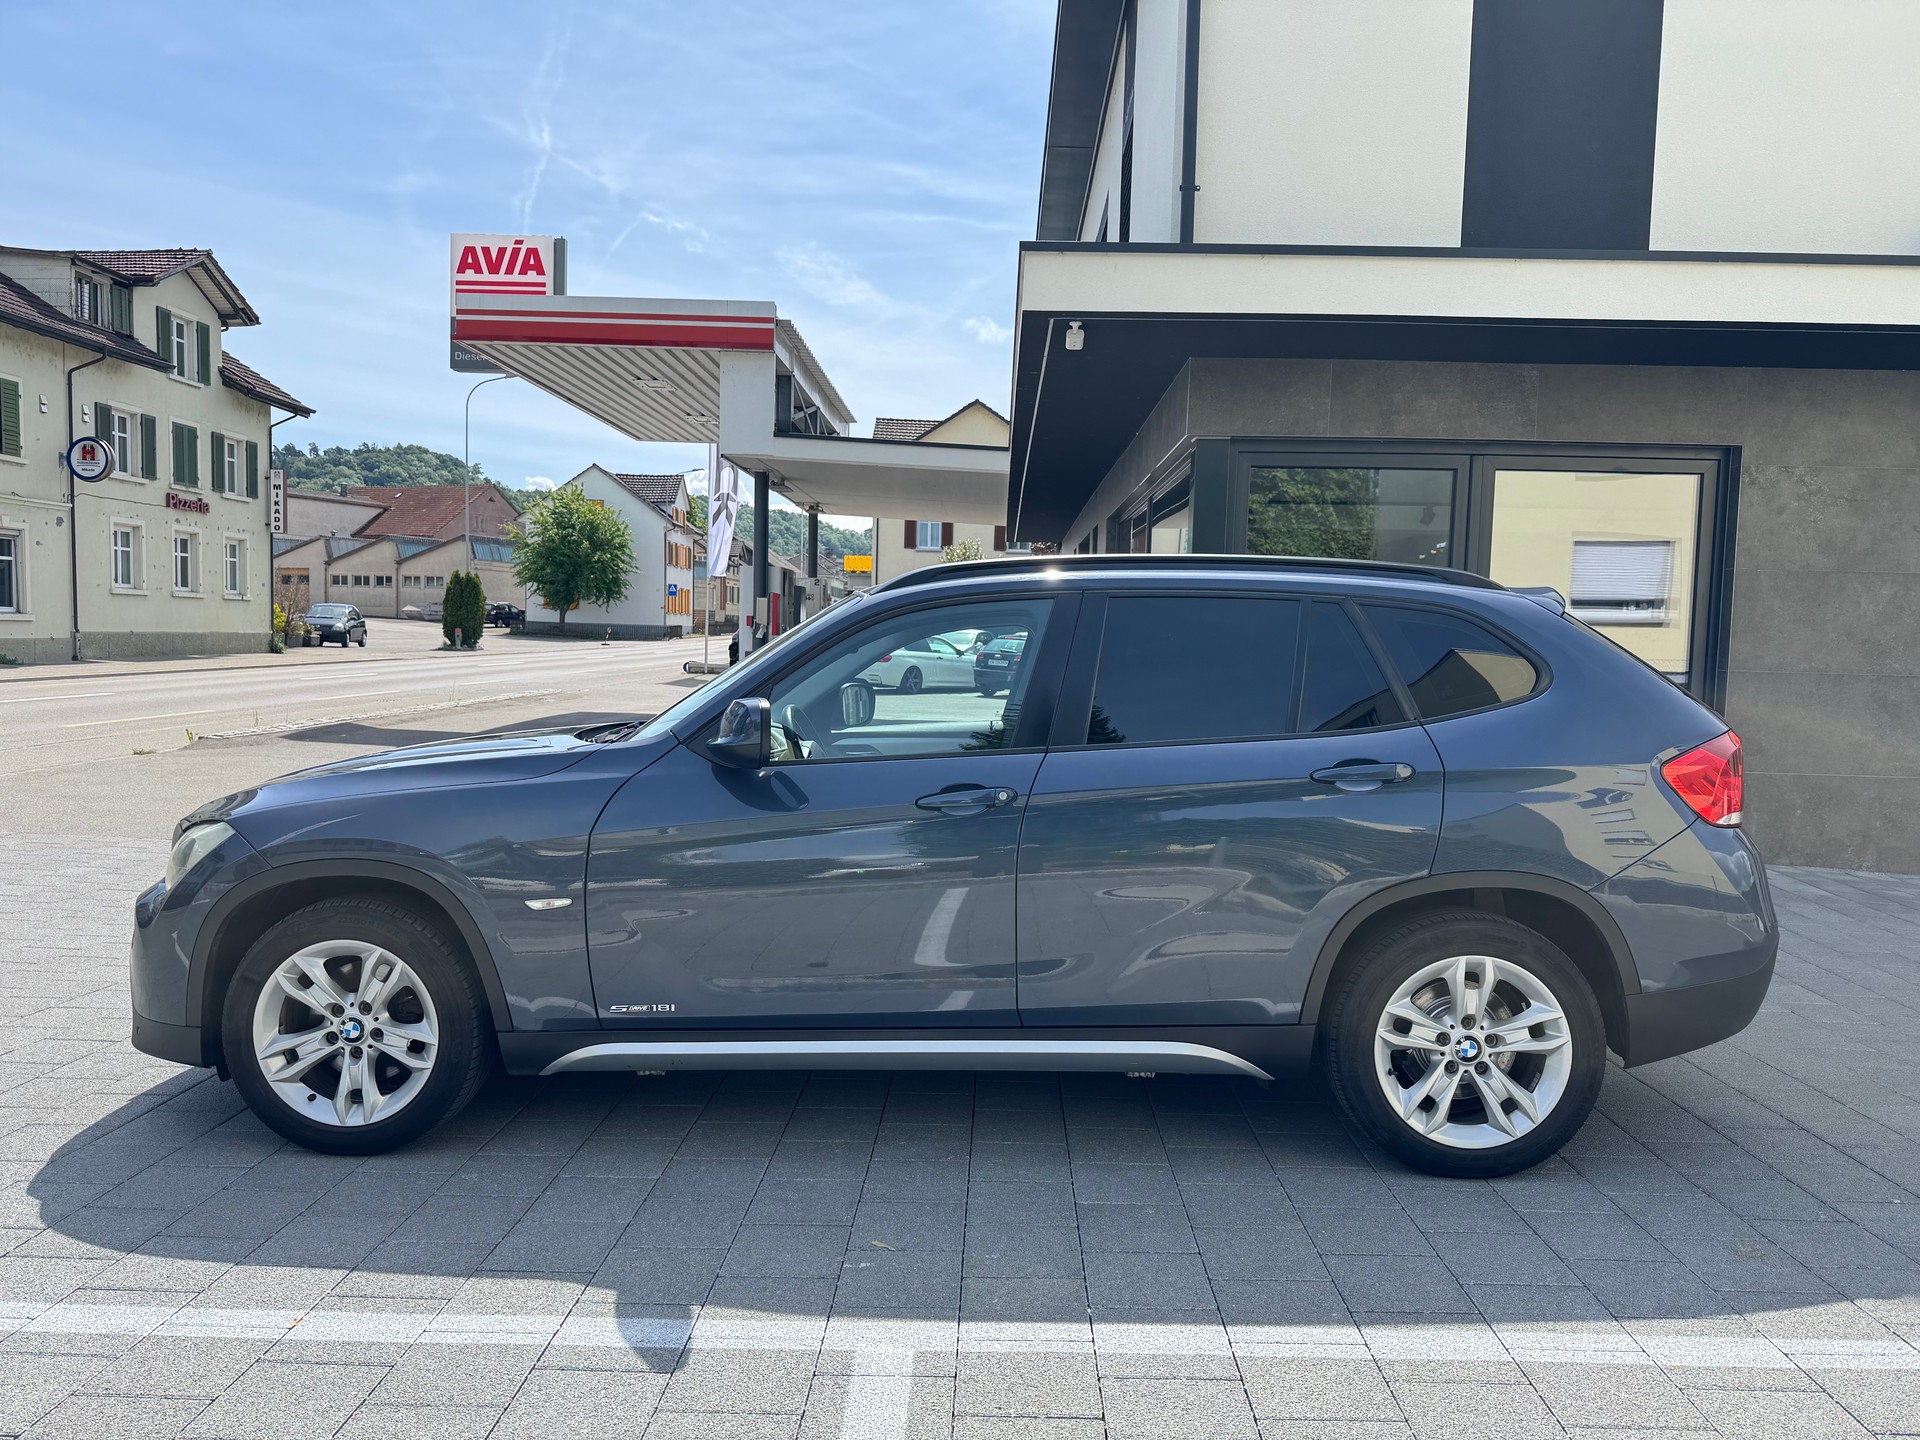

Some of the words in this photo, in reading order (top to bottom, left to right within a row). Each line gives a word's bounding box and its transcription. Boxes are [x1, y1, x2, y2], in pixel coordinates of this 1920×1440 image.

[455, 351, 485, 361] Diese
[169, 493, 211, 514] Pizzeria
[273, 484, 281, 531] MIKADO
